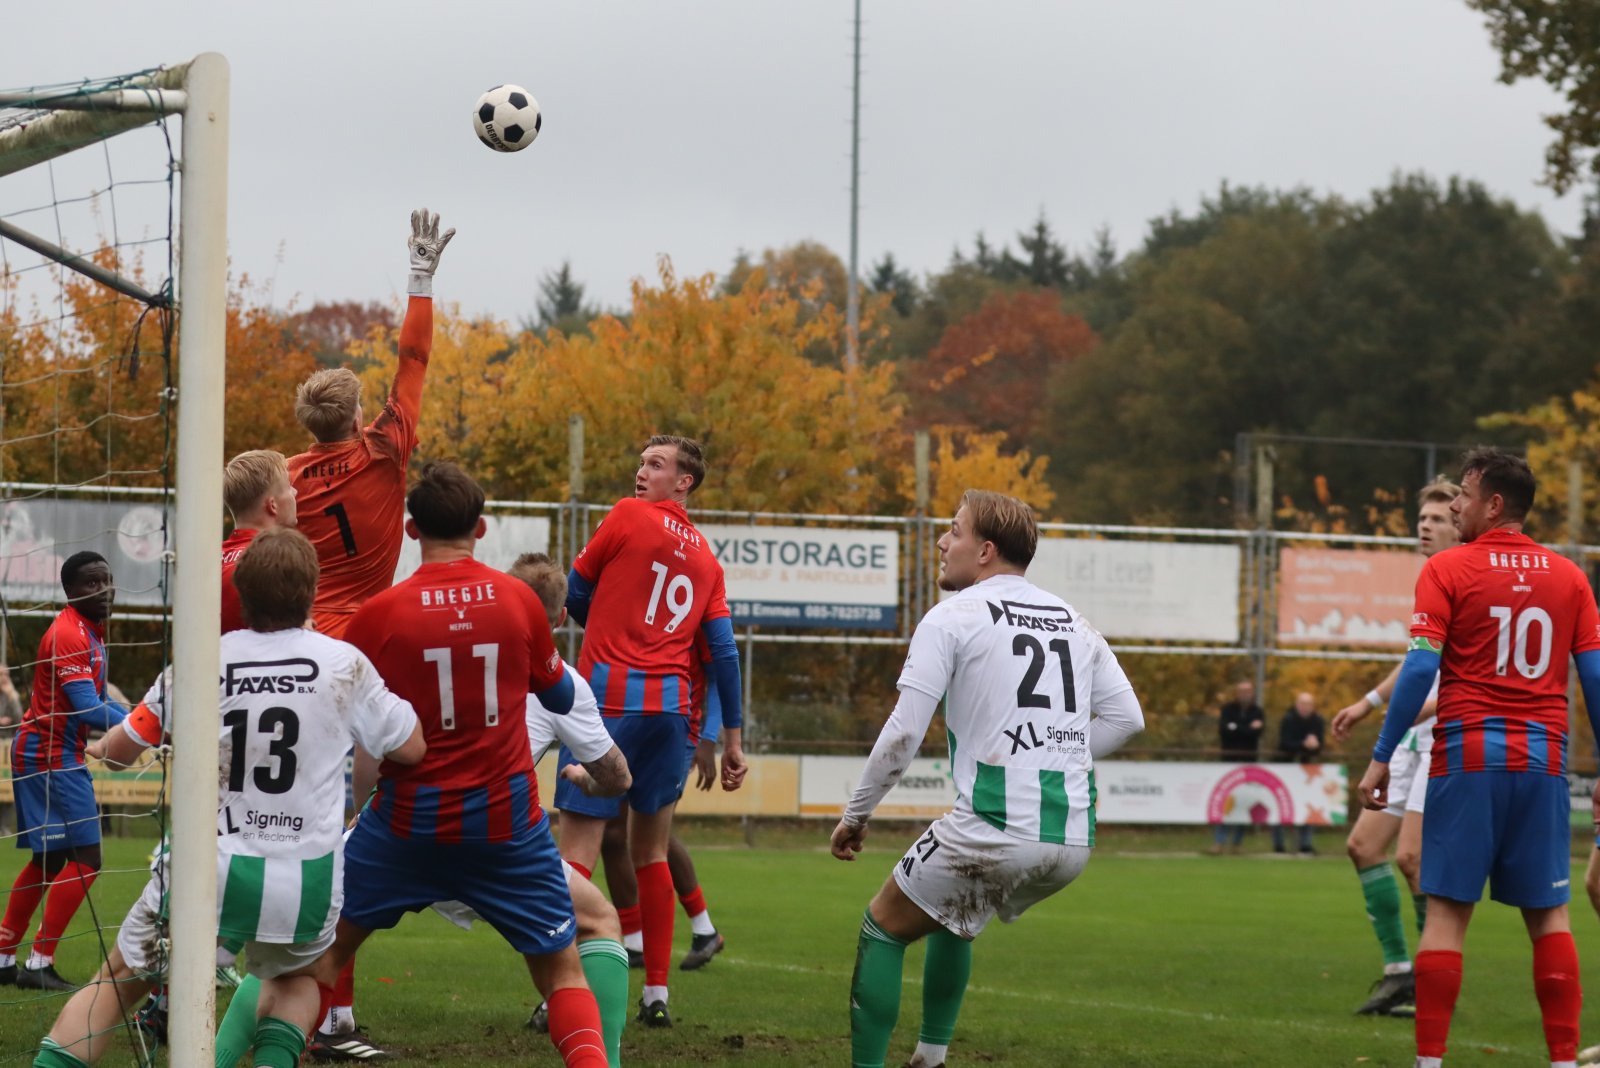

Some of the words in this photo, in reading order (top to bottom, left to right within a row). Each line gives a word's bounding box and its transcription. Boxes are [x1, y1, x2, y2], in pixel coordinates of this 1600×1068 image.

[323, 502, 358, 558] 1
[663, 515, 700, 547] BREGJE
[1489, 552, 1550, 569] BREGJE
[421, 583, 496, 606] BREGJE
[644, 560, 694, 634] 19
[752, 603, 800, 618] Emmen
[1489, 605, 1553, 680] 10
[423, 642, 500, 730] 11
[1012, 633, 1077, 714] 21
[223, 706, 300, 795] 13
[1003, 721, 1045, 756] XL
[1046, 725, 1086, 746] Signing
[218, 805, 240, 837] L
[245, 809, 304, 832] Signing
[242, 831, 256, 840] en
[258, 831, 301, 843] Reclame
[915, 828, 940, 864] 21
